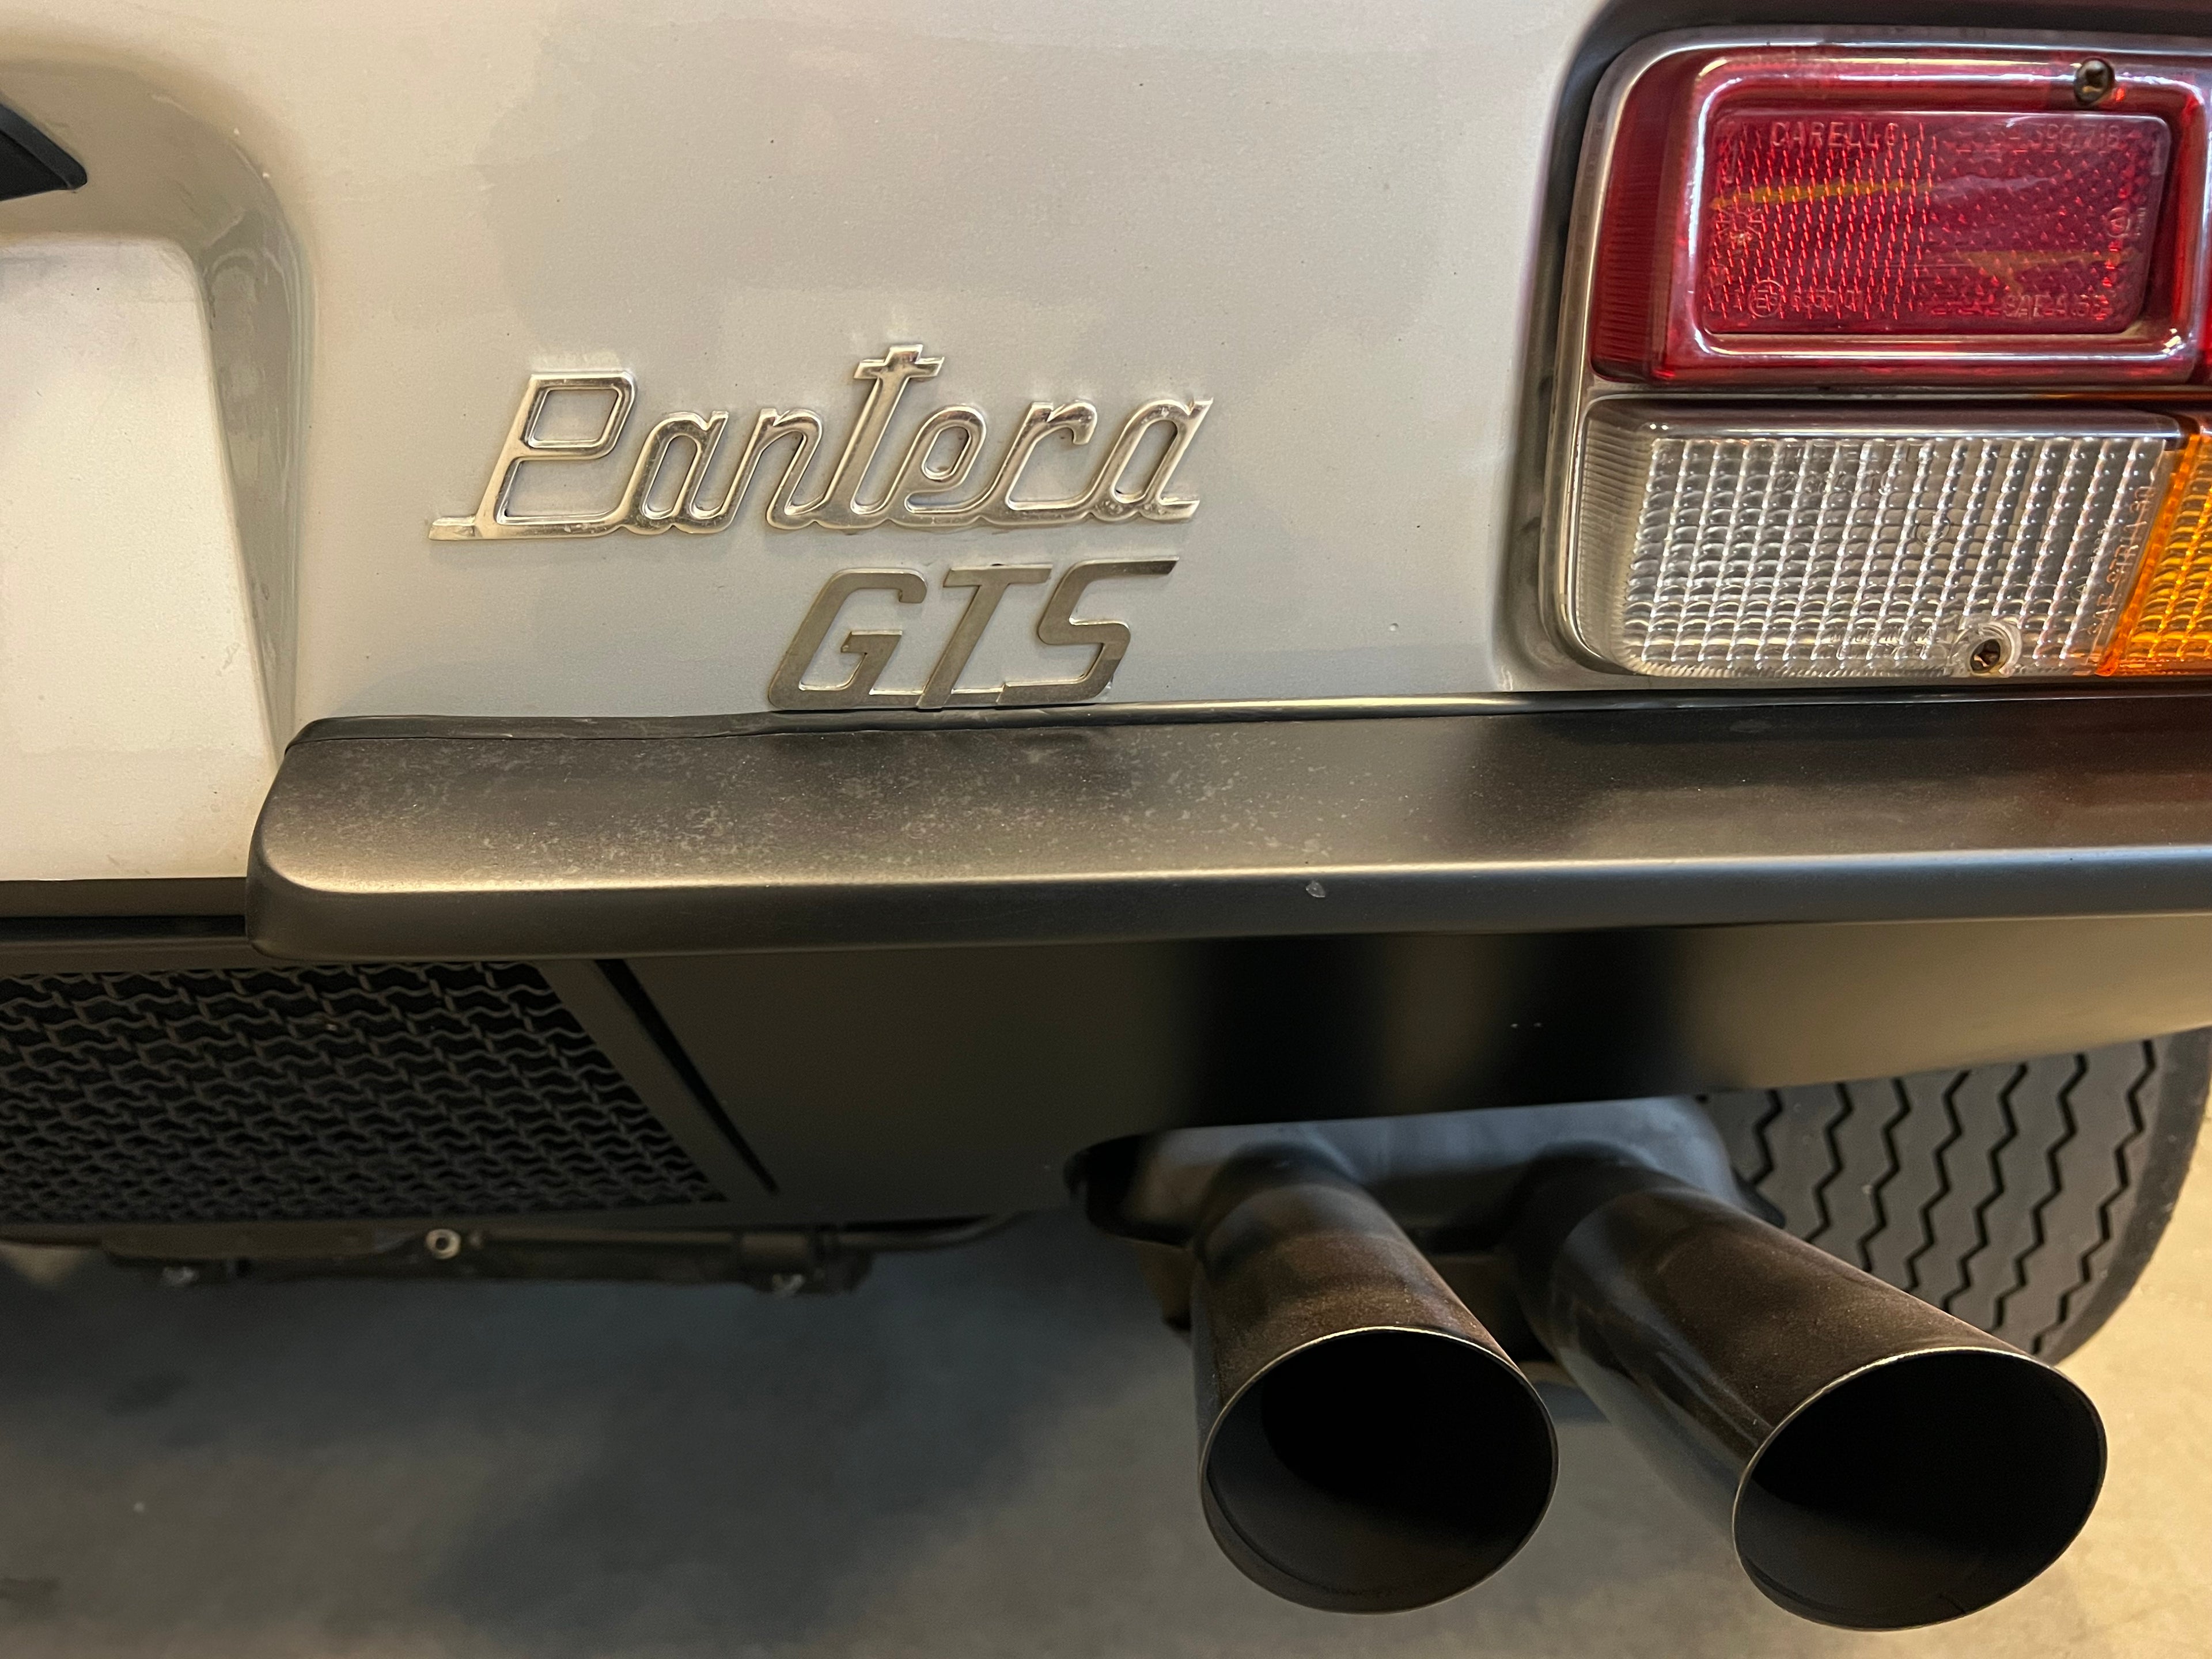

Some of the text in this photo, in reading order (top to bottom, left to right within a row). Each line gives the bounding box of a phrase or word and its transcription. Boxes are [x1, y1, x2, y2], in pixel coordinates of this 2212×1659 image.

[1771, 120, 1900, 148] CARELLO
[427, 343, 1213, 540] Pantera
[767, 554, 1180, 710] GTS
